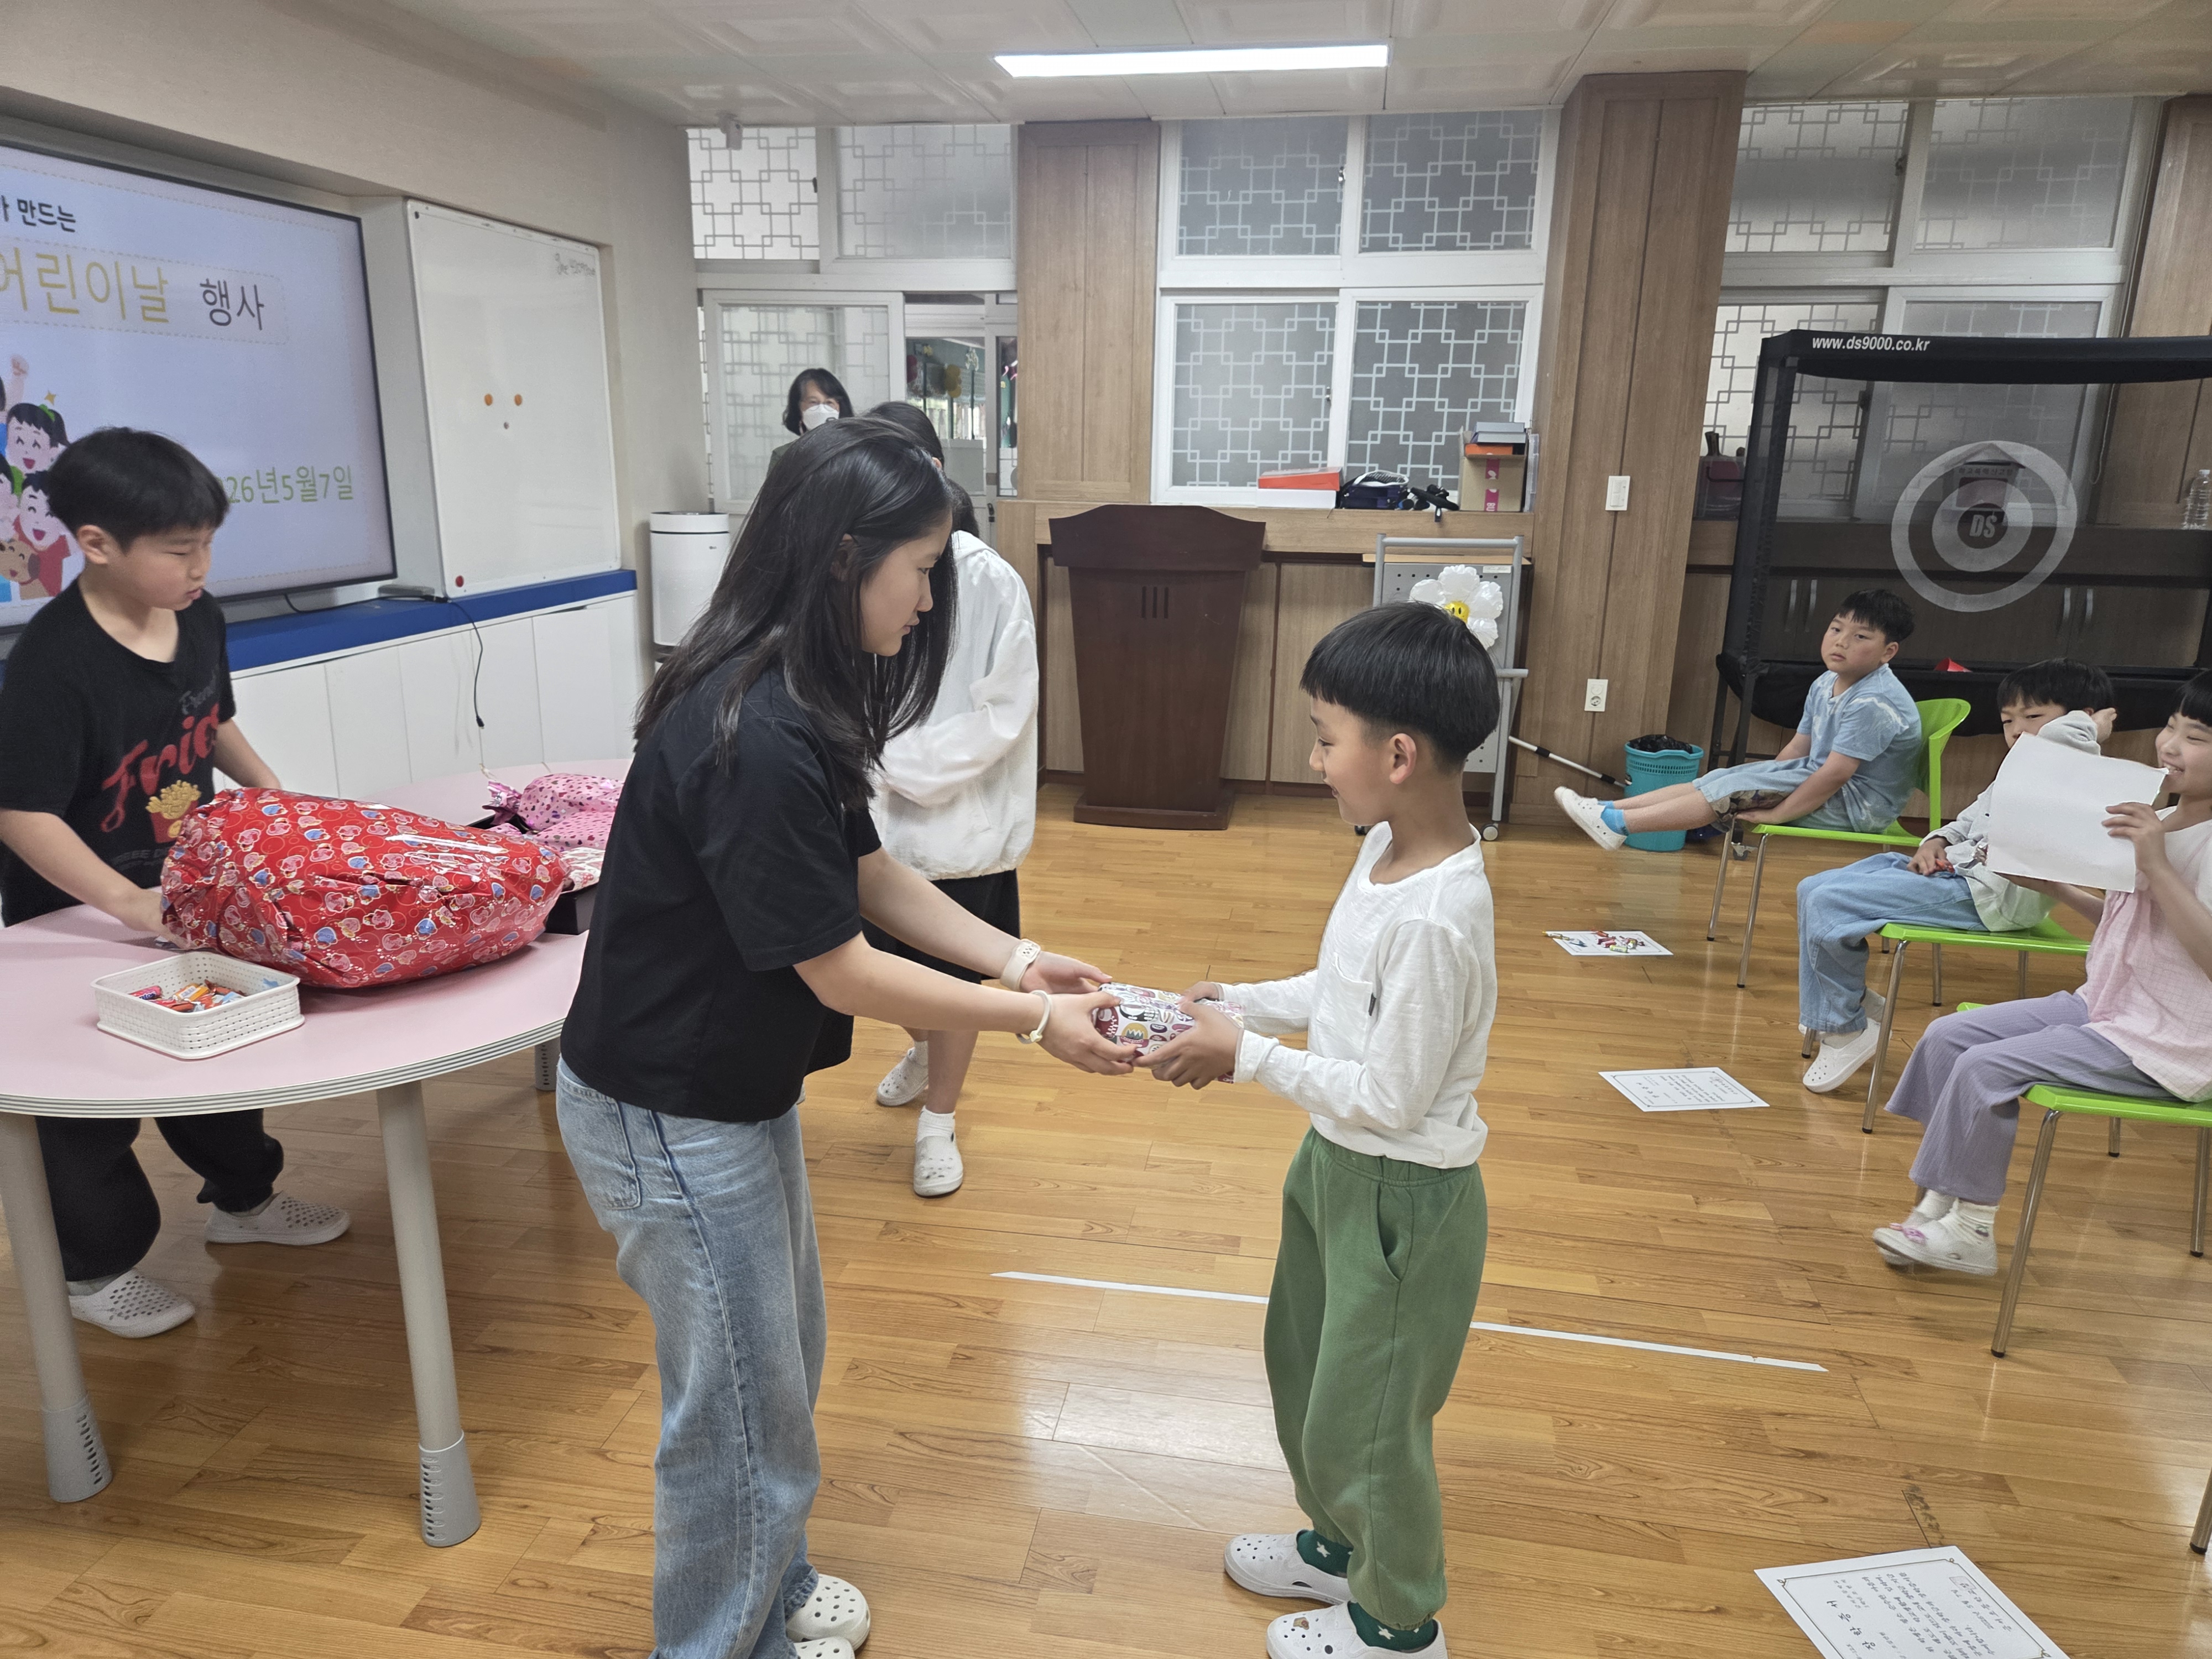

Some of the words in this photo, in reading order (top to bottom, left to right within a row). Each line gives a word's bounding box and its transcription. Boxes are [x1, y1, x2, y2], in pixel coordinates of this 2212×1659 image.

[17, 199, 76, 232] 만드는
[0, 247, 169, 323] 어린이날
[200, 278, 264, 331] 행사
[1812, 336, 1930, 351] www.ds9000.co.kr
[220, 465, 354, 504] 26년5월7일
[1969, 514, 1997, 538] DS
